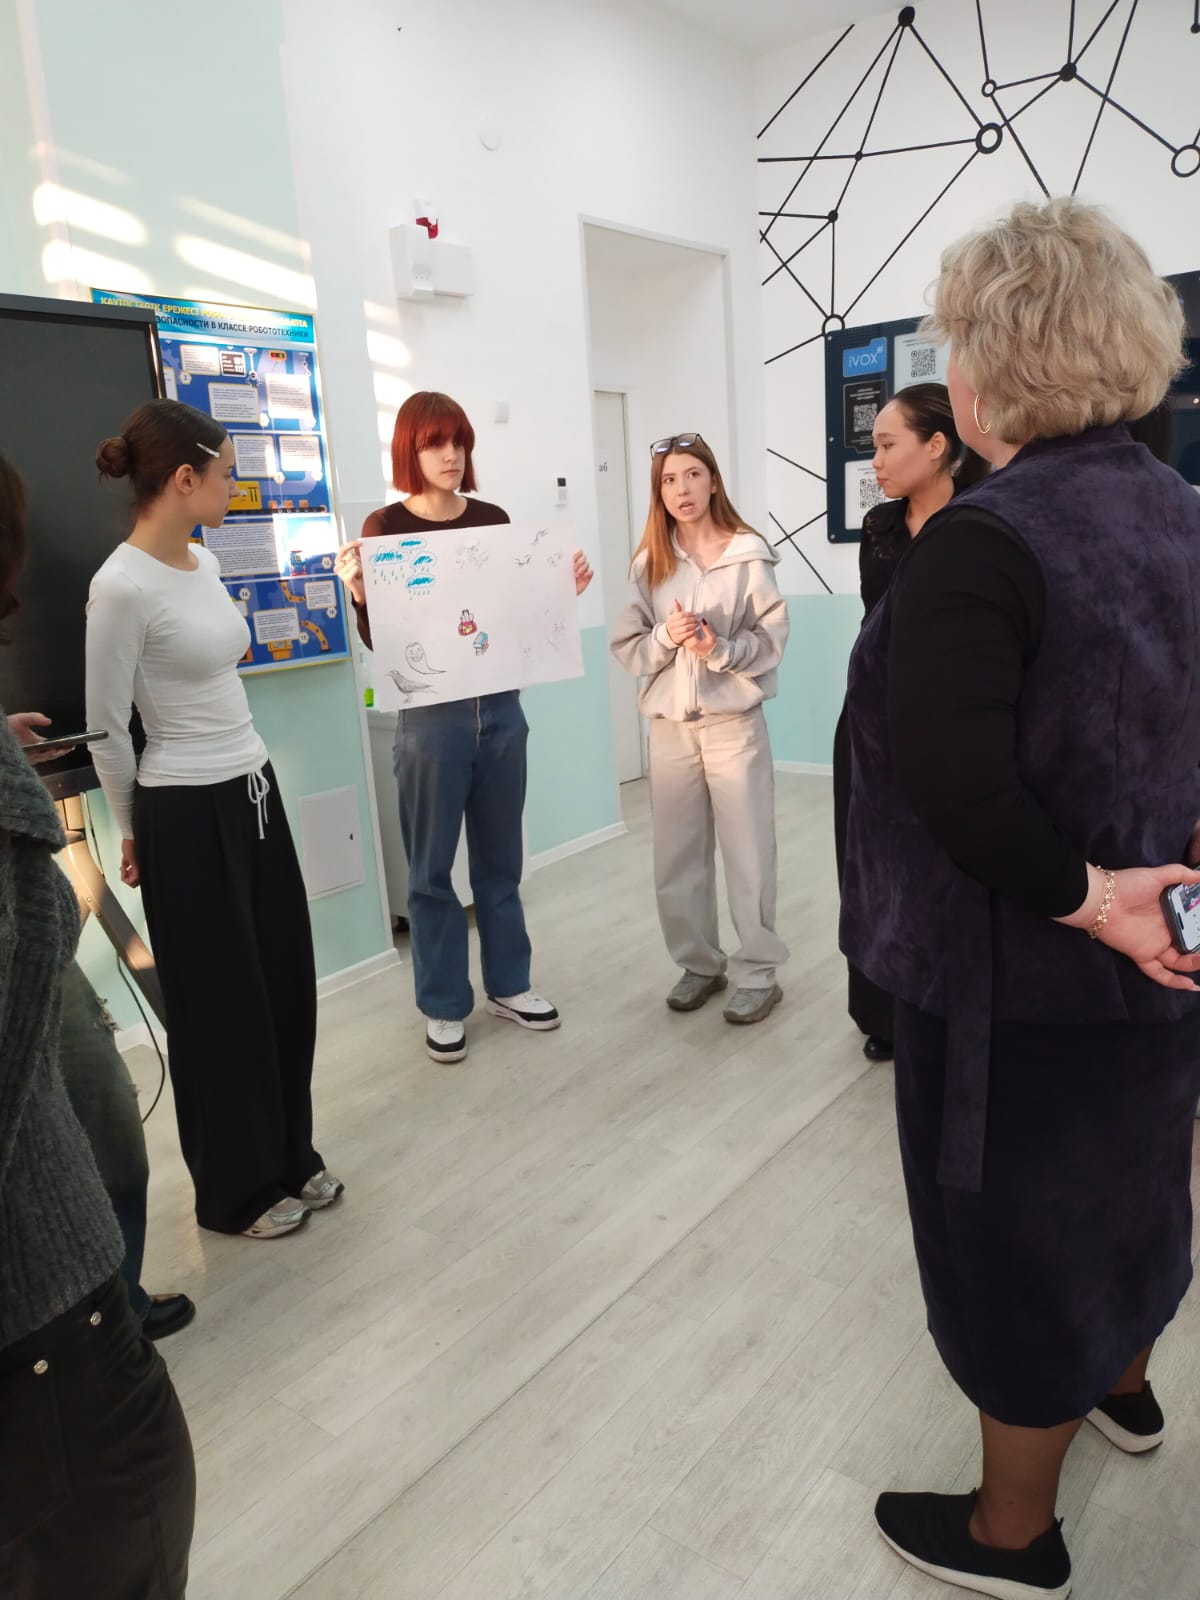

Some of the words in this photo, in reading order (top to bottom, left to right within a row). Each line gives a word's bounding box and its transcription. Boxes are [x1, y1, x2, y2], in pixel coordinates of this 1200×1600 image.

[155, 315, 209, 329] ЗОПАСНОСТИ
[211, 321, 217, 329] В
[218, 322, 247, 333] КЛАССЕ
[248, 325, 309, 338] РОБОТОТЕХНИКИ
